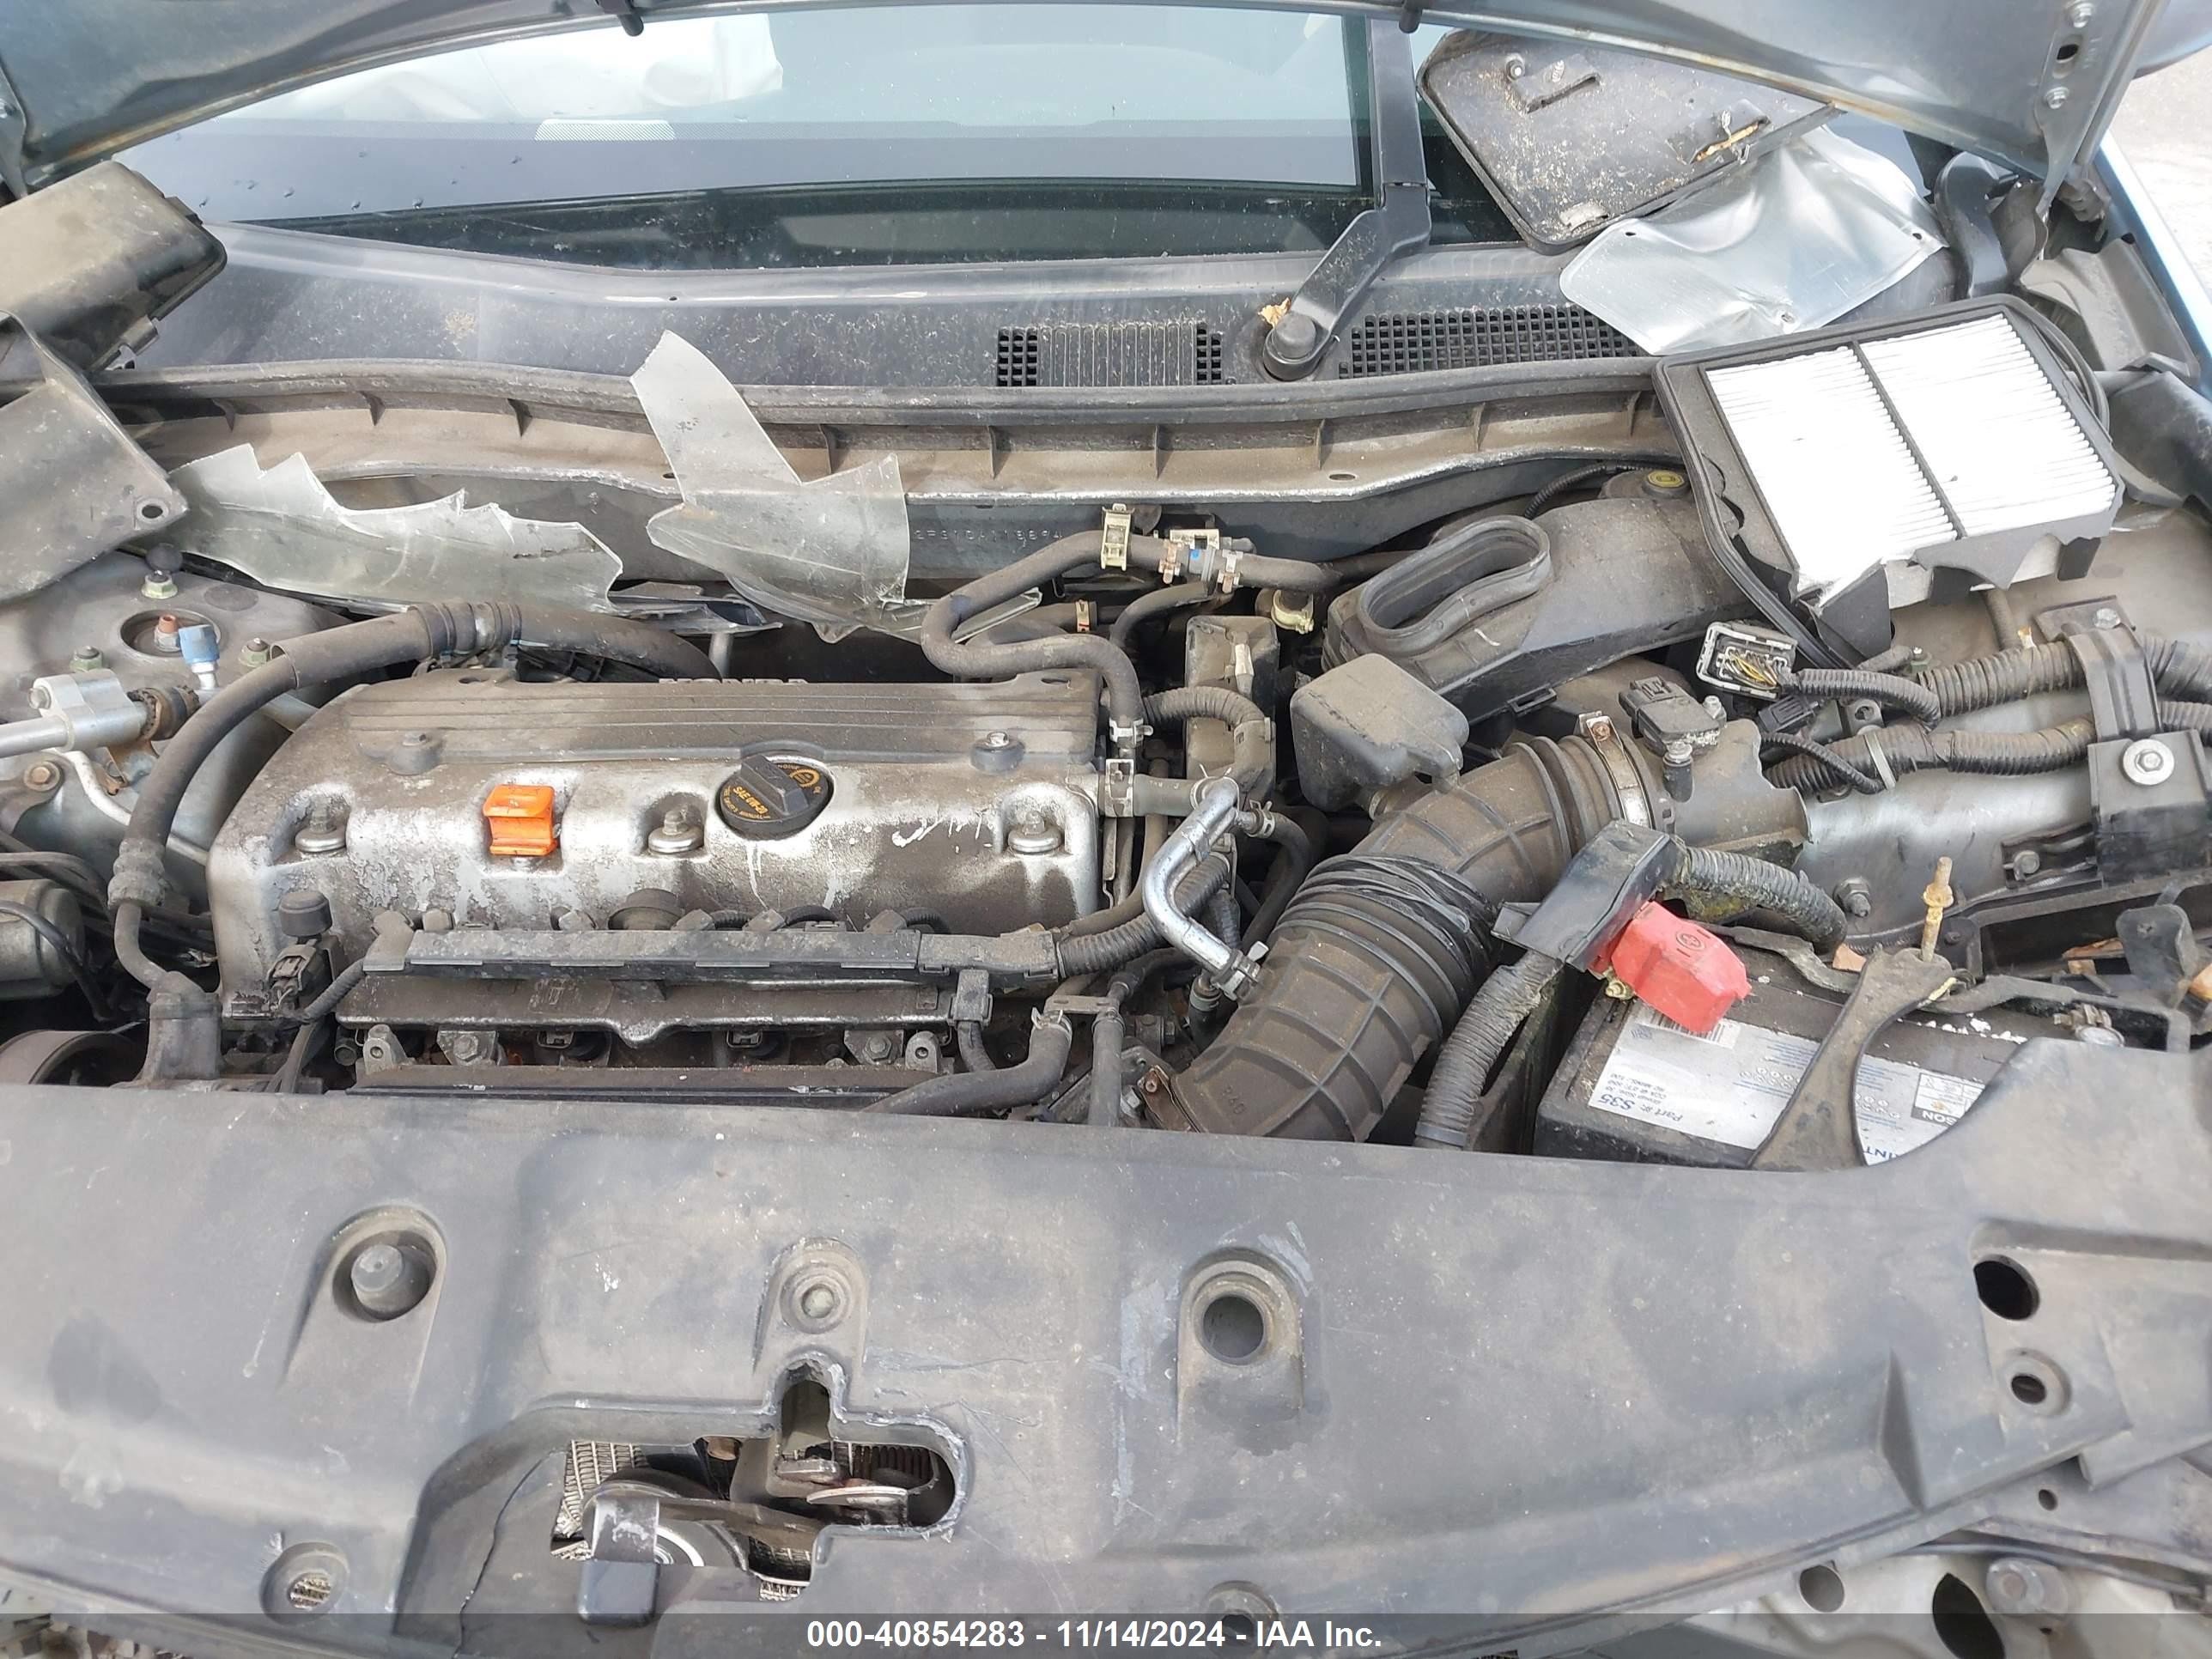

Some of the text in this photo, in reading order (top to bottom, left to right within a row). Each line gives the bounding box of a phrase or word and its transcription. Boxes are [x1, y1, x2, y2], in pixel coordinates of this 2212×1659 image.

[732, 786, 751, 800] SAE
[1597, 1093, 1636, 1111] S35
[1654, 1108, 1684, 1122] Part
